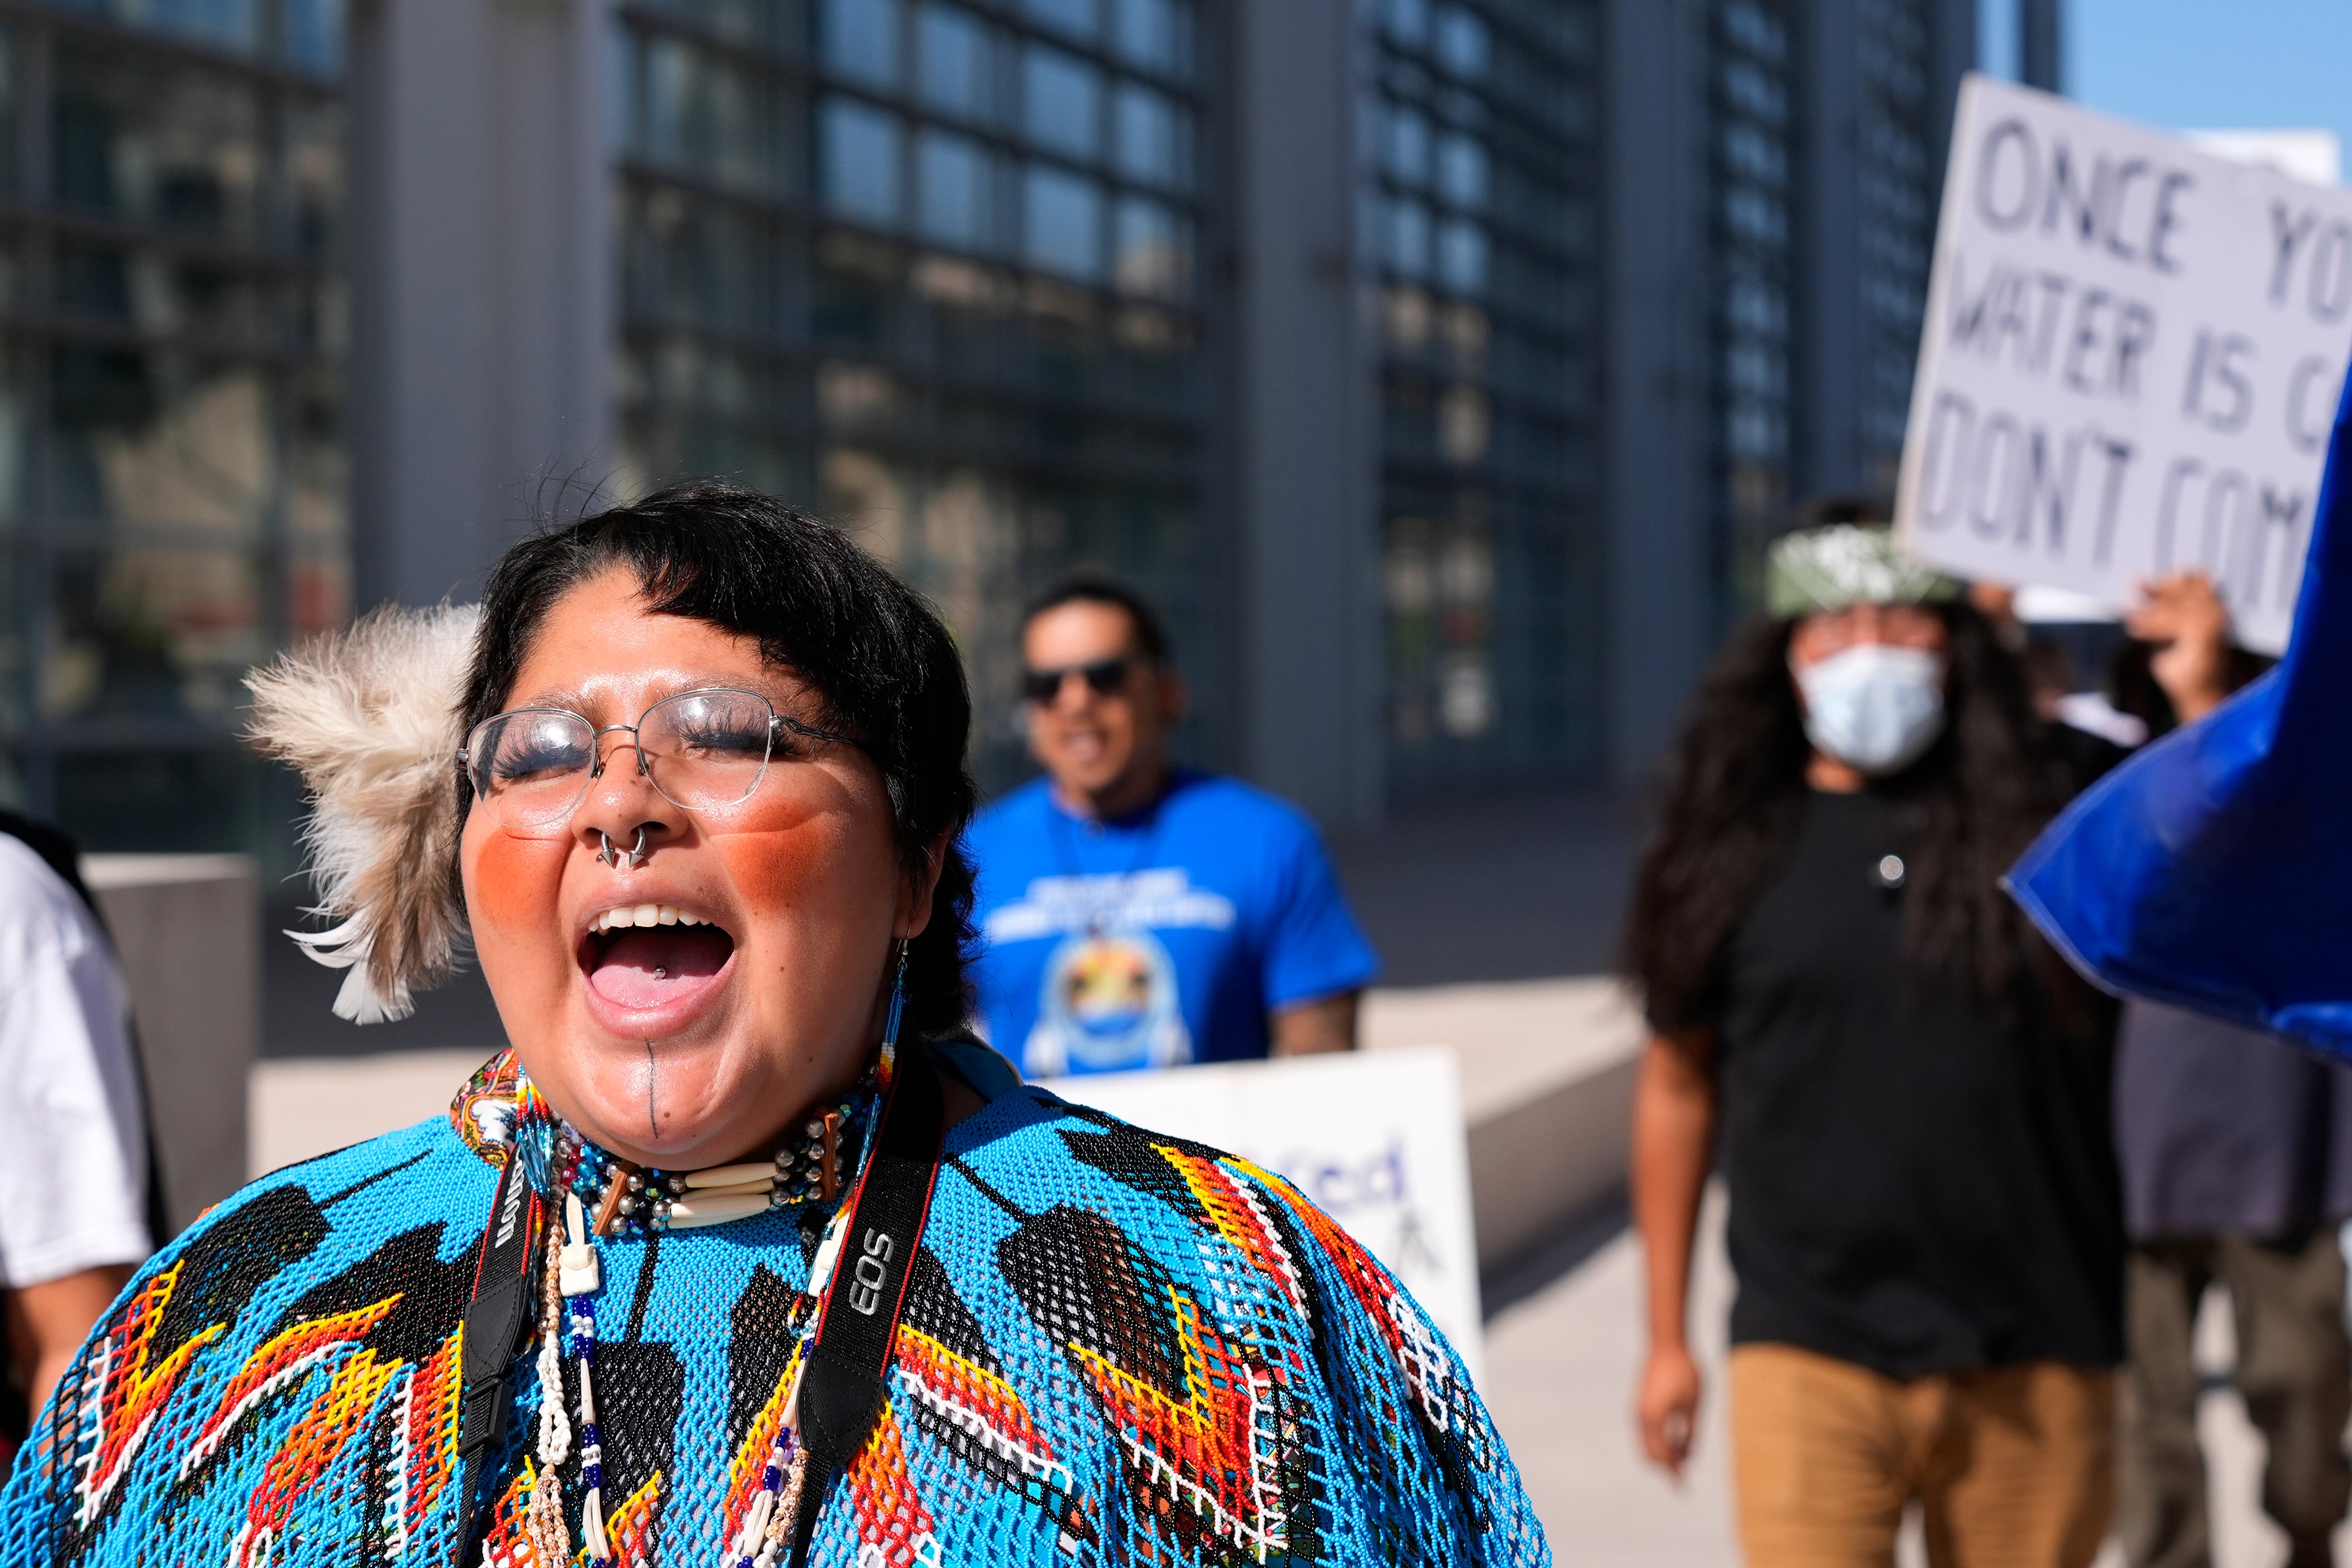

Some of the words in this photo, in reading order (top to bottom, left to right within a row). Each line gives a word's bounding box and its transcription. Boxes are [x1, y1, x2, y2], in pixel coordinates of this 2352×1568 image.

[1974, 115, 2194, 274] ONCE
[1950, 250, 2156, 400] WATER
[2181, 325, 2257, 435] IS
[849, 1228, 894, 1316] EOS
